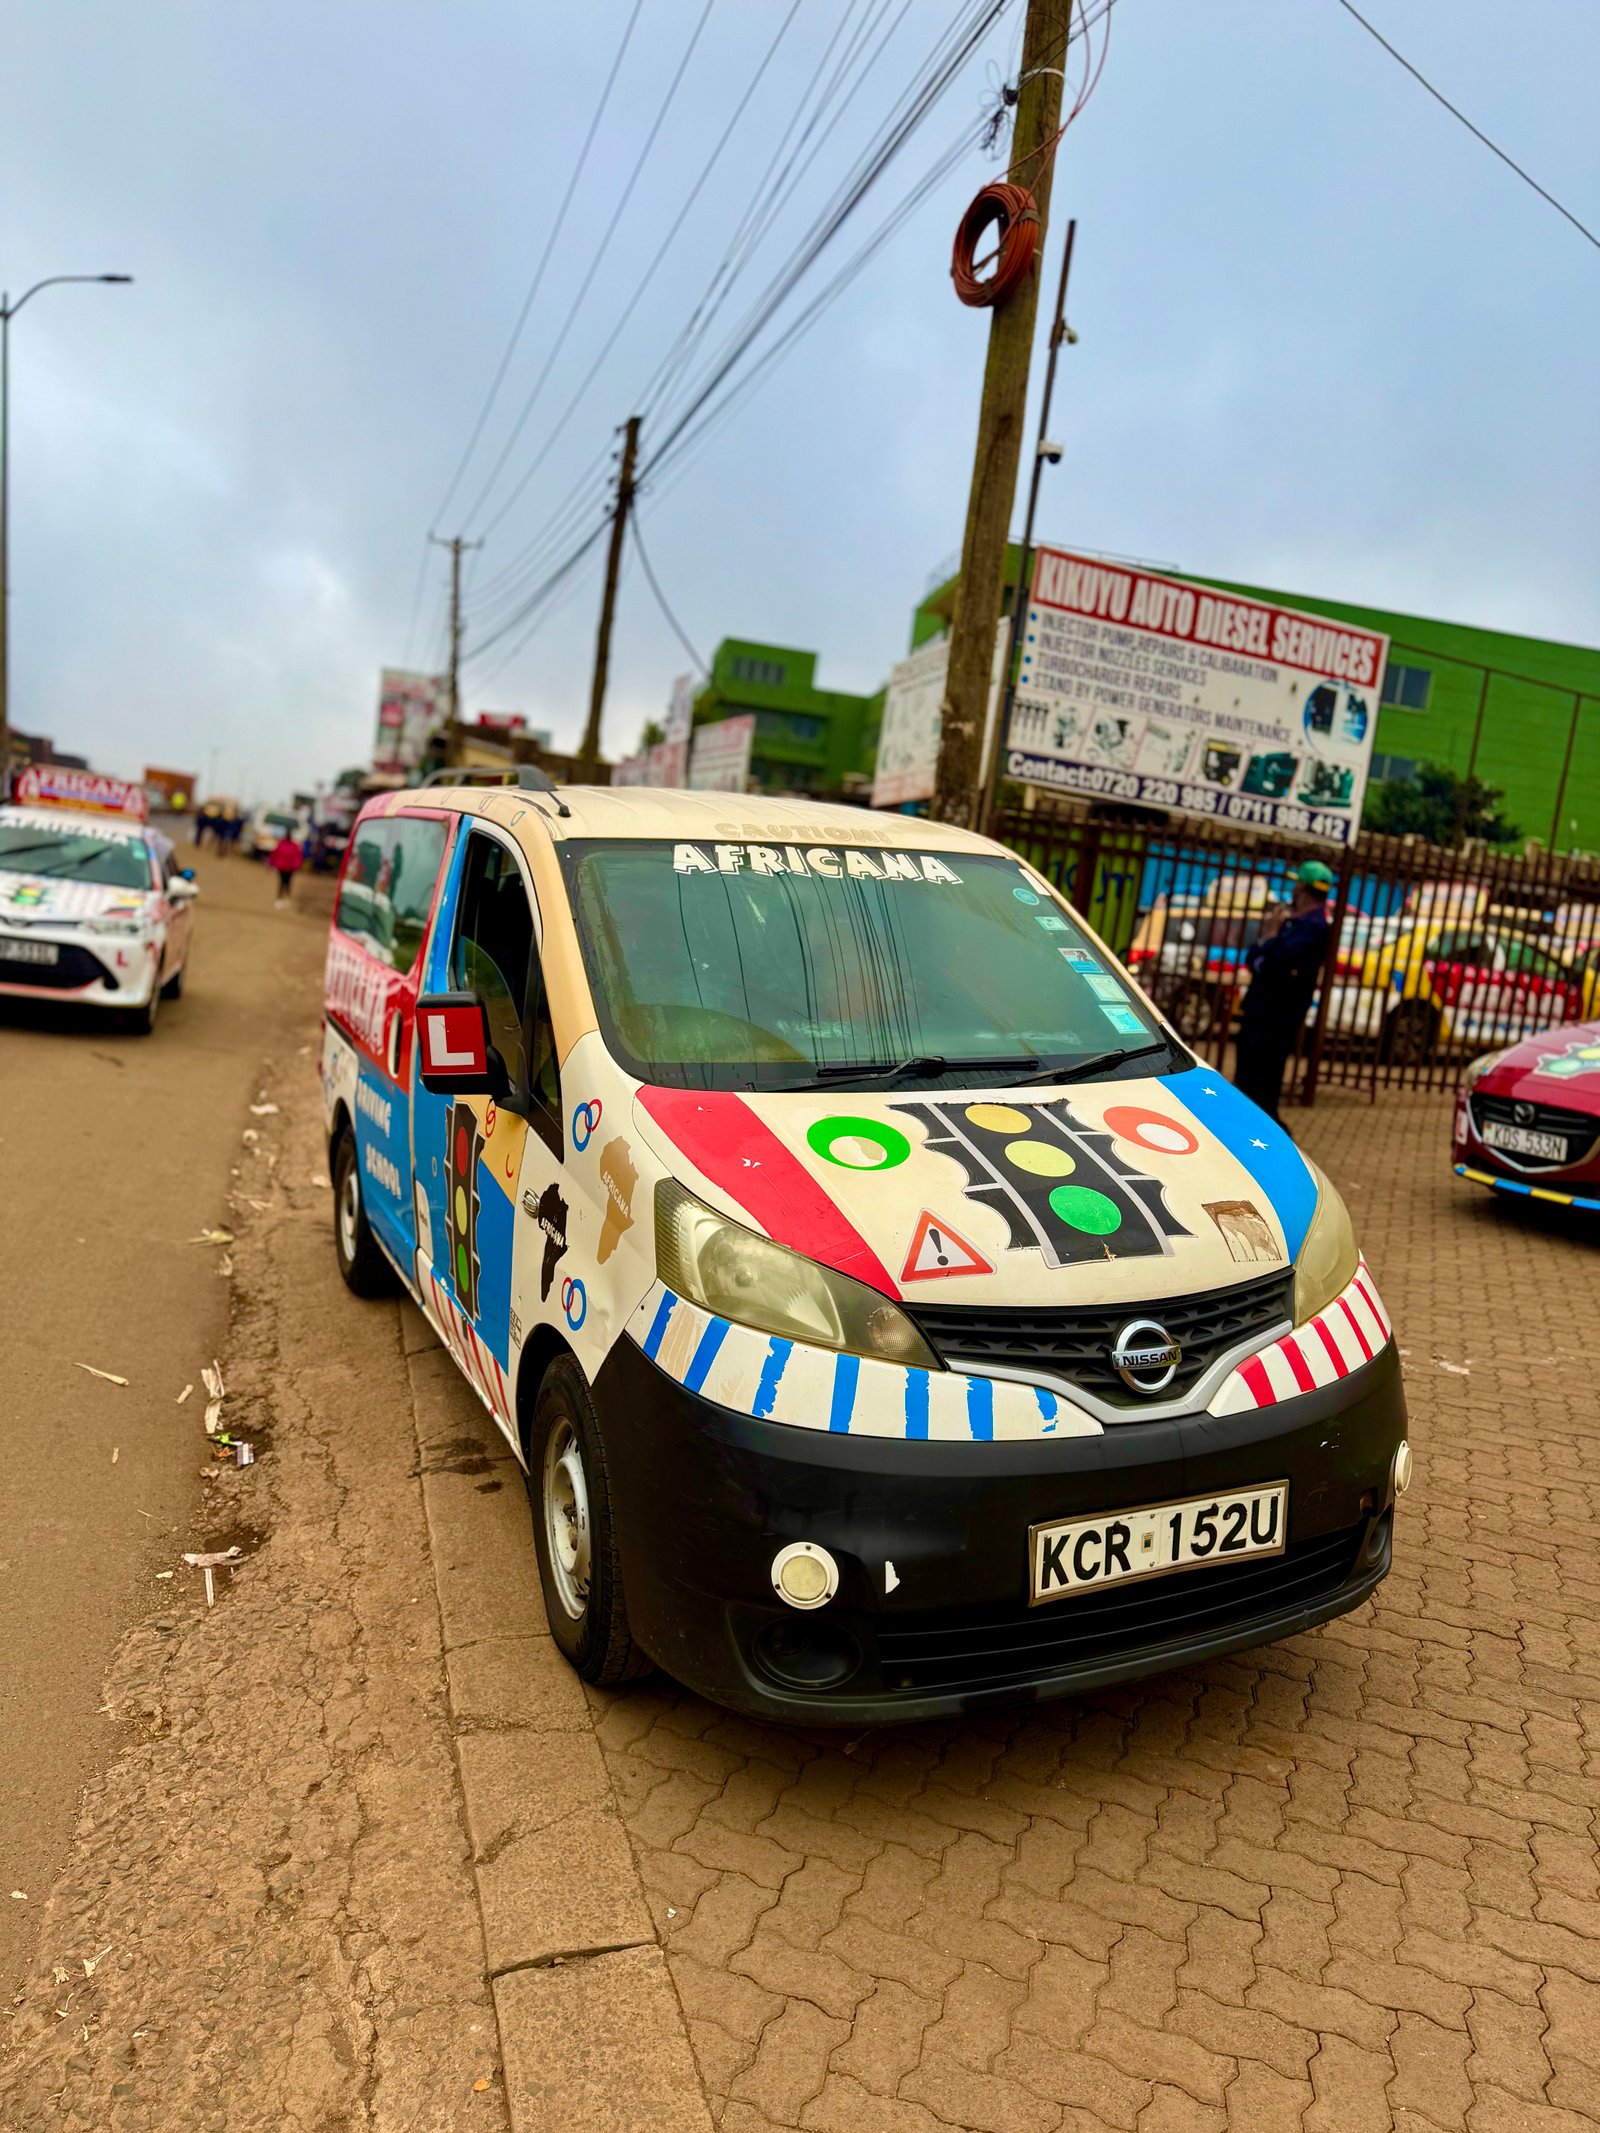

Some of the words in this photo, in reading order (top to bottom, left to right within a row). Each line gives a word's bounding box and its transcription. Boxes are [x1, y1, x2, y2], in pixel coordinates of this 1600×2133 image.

[1036, 552, 1132, 622] KIKUYU
[1128, 577, 1196, 637] AUTO
[1194, 596, 1271, 657] DIESEL
[1271, 614, 1376, 684] SERVICES
[1042, 612, 1098, 639] INJECTOR
[1036, 651, 1132, 689] TURBOCHARGER
[1133, 673, 1182, 700] REPAIRS
[1039, 631, 1096, 661] INJECTOR
[1098, 647, 1150, 674] NOZZLES
[1151, 660, 1207, 687] SERVICES
[1032, 671, 1074, 695] STAND
[1074, 681, 1091, 699] BY
[1093, 685, 1136, 708] POWER
[1137, 693, 1213, 728] GENERATORS
[1213, 710, 1292, 744] MAINTENANCE
[714, 821, 893, 845] CAUTION!
[1141, 778, 1180, 806] 220
[1228, 795, 1273, 825] 0711
[1310, 815, 1346, 841] 412
[672, 843, 964, 885] AFRICANA
[428, 1015, 475, 1066] L
[1493, 1122, 1520, 1151] KDS
[1525, 1133, 1563, 1162] 533N
[366, 1143, 402, 1201] SCHOOL
[602, 1170, 629, 1218] AFRICANA
[540, 1216, 564, 1248] AFRICANA
[1122, 1350, 1179, 1367] NISSAN
[1041, 1520, 1132, 1590] KCR
[1169, 1495, 1279, 1562] 152U
